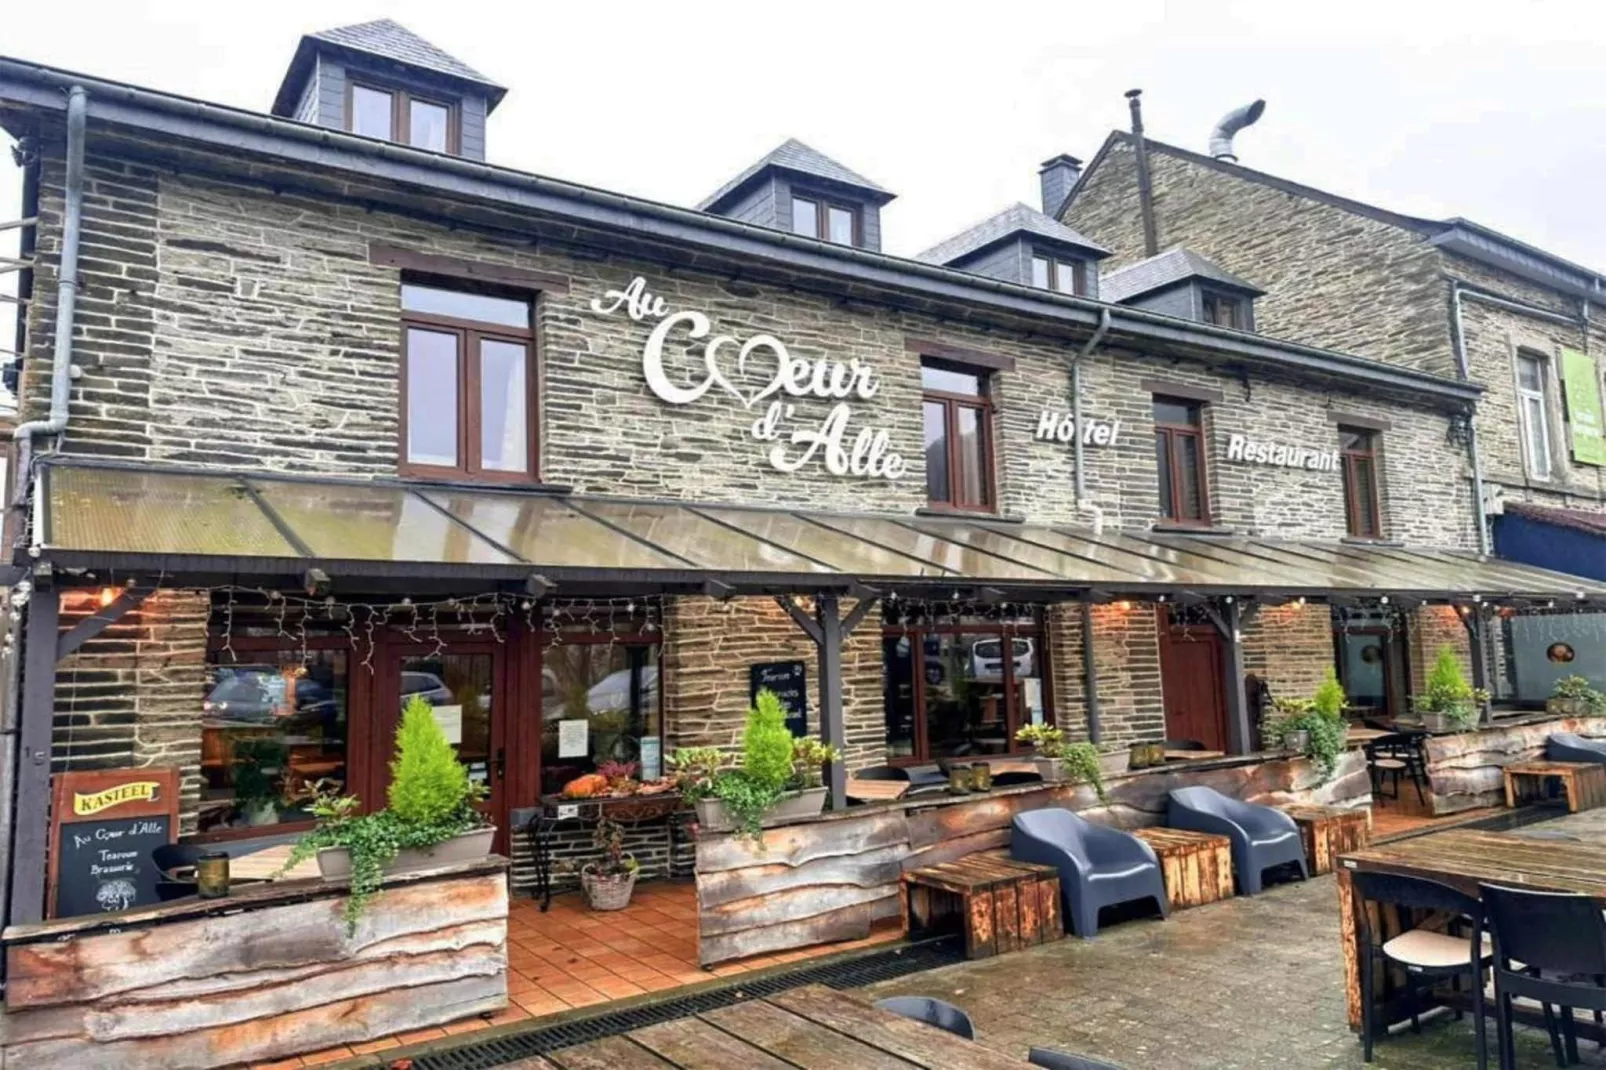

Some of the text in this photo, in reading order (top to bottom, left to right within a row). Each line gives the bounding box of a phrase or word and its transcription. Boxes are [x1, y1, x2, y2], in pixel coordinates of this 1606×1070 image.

[591, 276, 669, 320] Au
[751, 402, 905, 479] d'Alle
[1227, 433, 1341, 471] Restaurant
[80, 784, 150, 812] KASTEEL
[73, 835, 92, 850] Au
[128, 821, 163, 835] d'Alle
[98, 849, 138, 861] Tearoom
